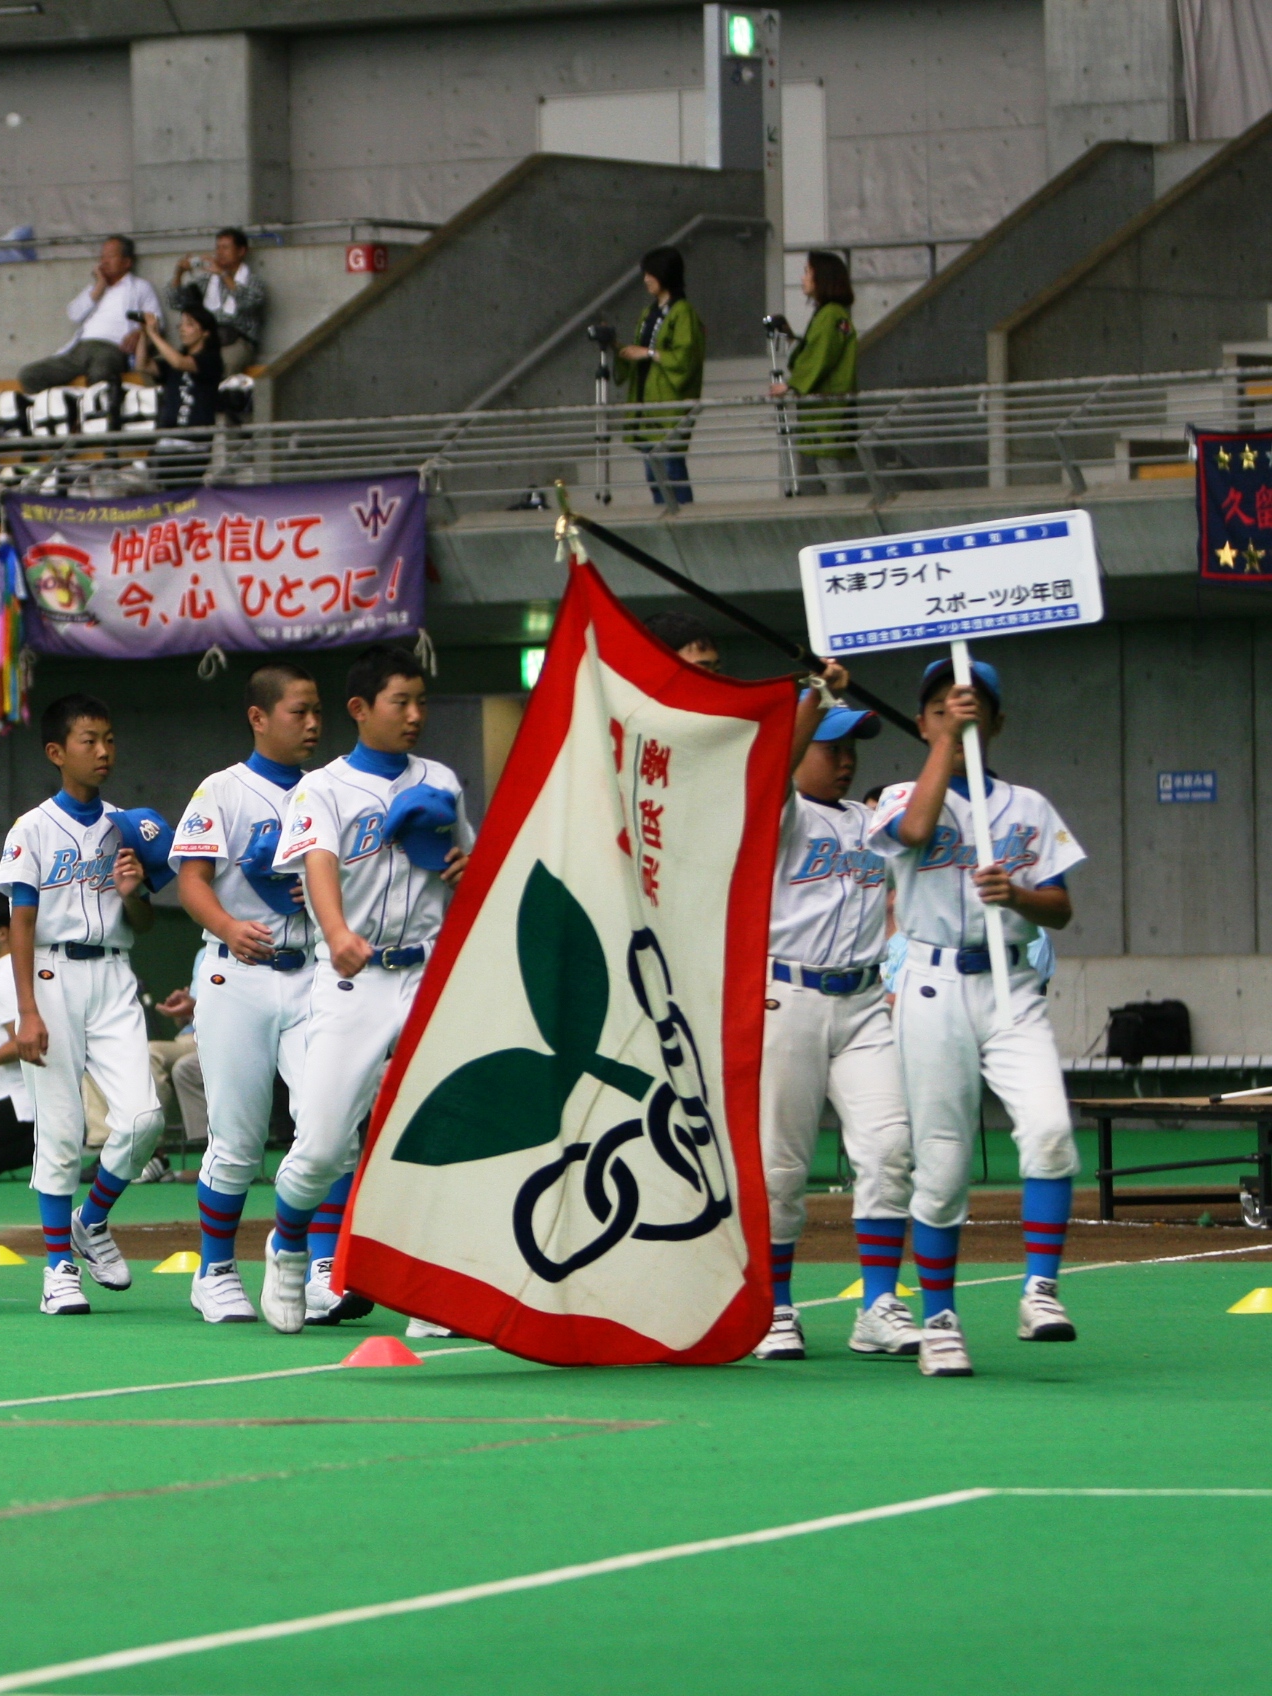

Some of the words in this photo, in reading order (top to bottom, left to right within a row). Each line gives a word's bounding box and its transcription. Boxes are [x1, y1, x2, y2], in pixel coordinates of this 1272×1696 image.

[349, 249, 365, 269] G
[111, 514, 323, 576] 仲間を信じて
[825, 562, 951, 594] 木津ブライト
[925, 579, 1074, 616] スポーツ少年団
